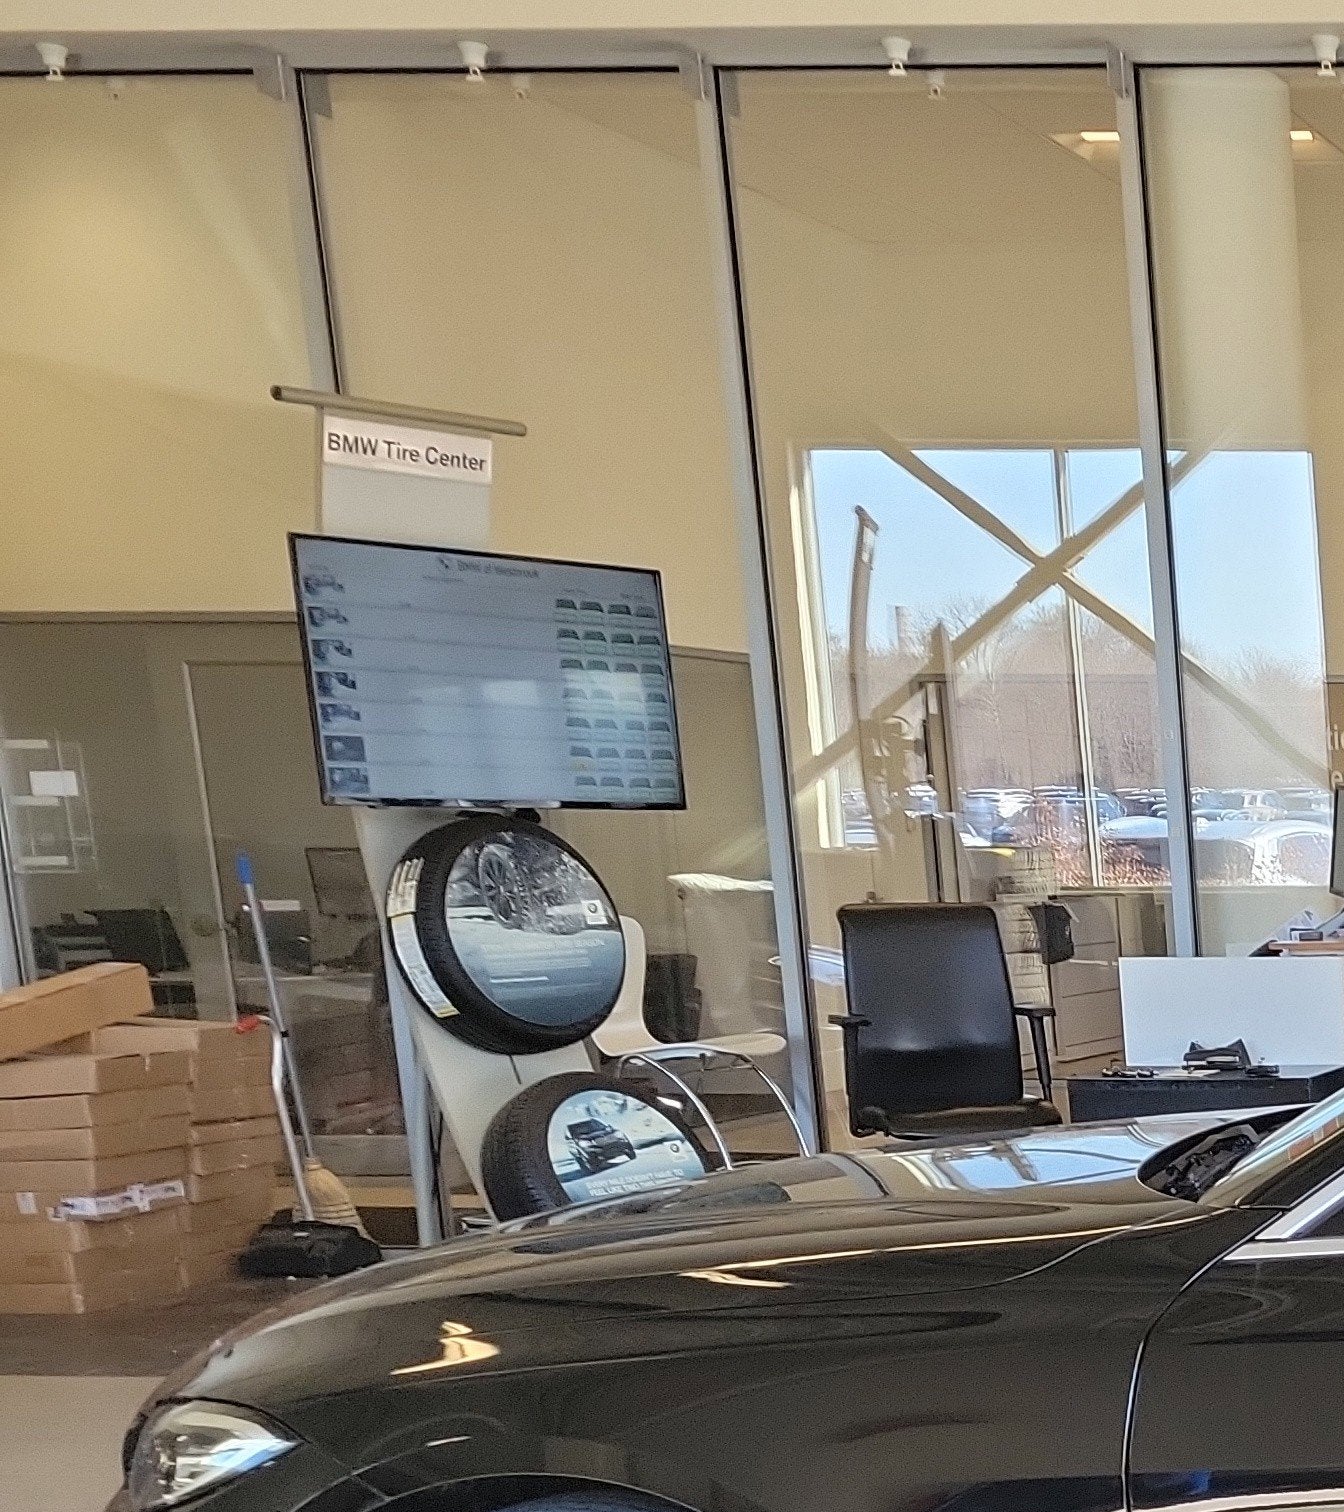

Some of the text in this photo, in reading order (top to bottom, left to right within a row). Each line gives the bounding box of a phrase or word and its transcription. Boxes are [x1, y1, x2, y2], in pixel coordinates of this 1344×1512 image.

[327, 432, 488, 472] BMW Tire Center
